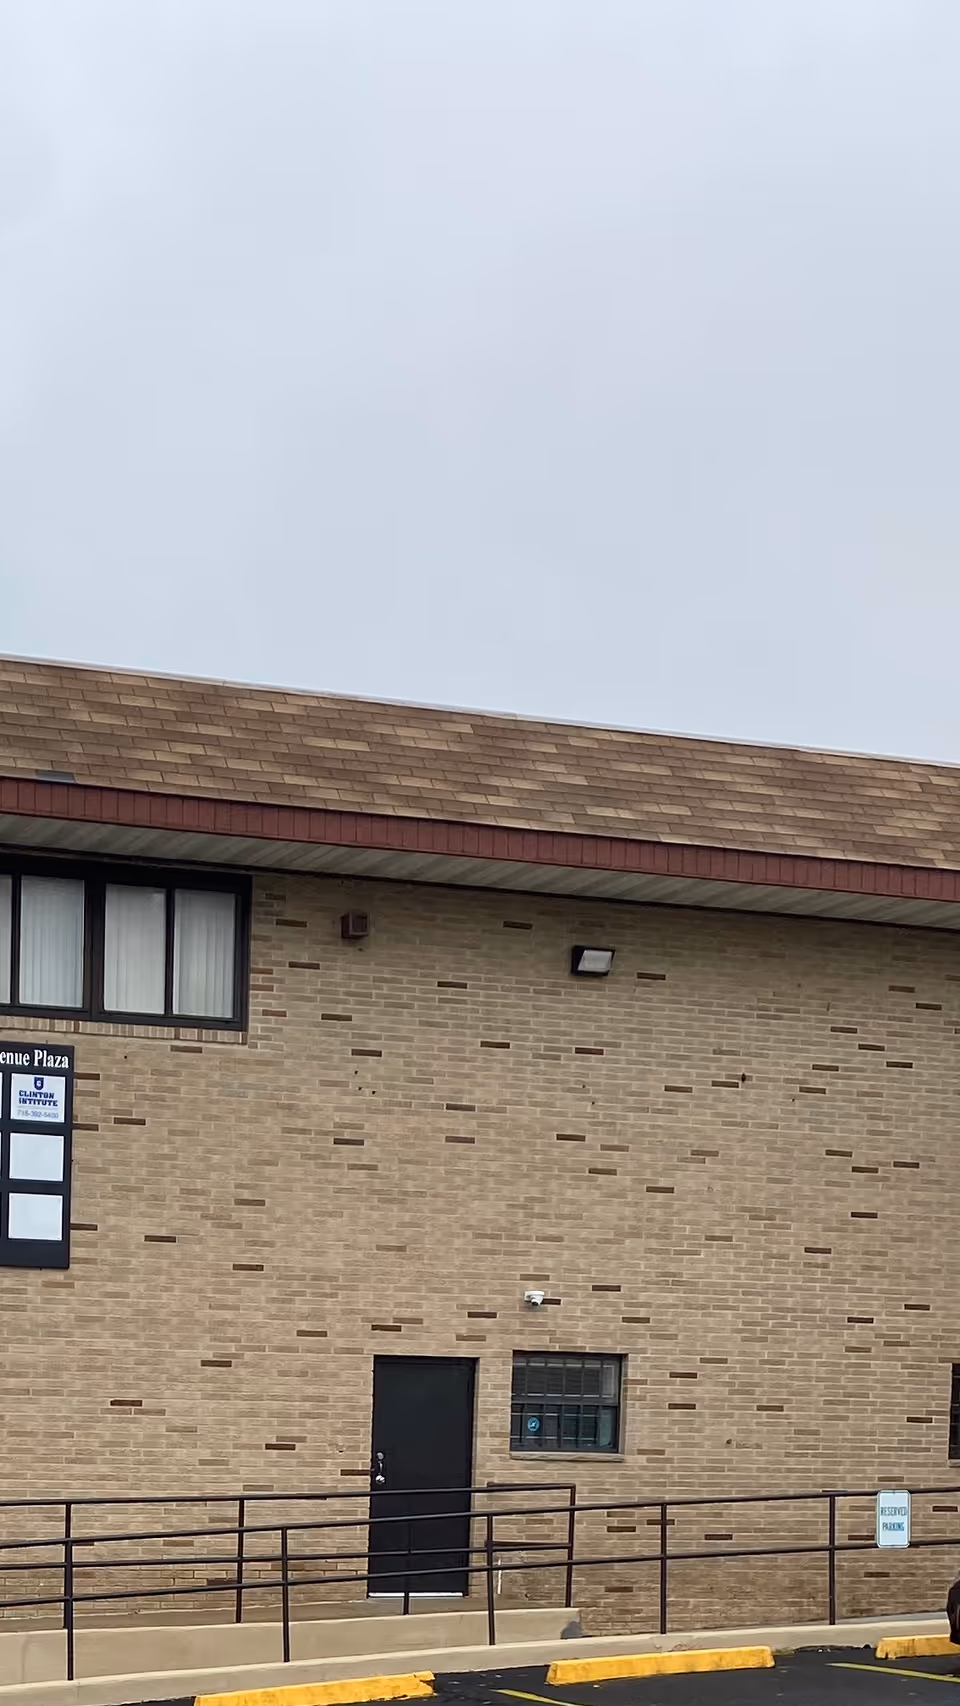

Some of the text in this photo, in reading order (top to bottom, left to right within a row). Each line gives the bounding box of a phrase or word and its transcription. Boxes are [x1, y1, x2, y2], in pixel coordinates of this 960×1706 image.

[33, 1049, 69, 1069] Plaza
[19, 1089, 55, 1099] CLINTON
[880, 1506, 908, 1516] RESERVED
[882, 1522, 905, 1532] PARKING
